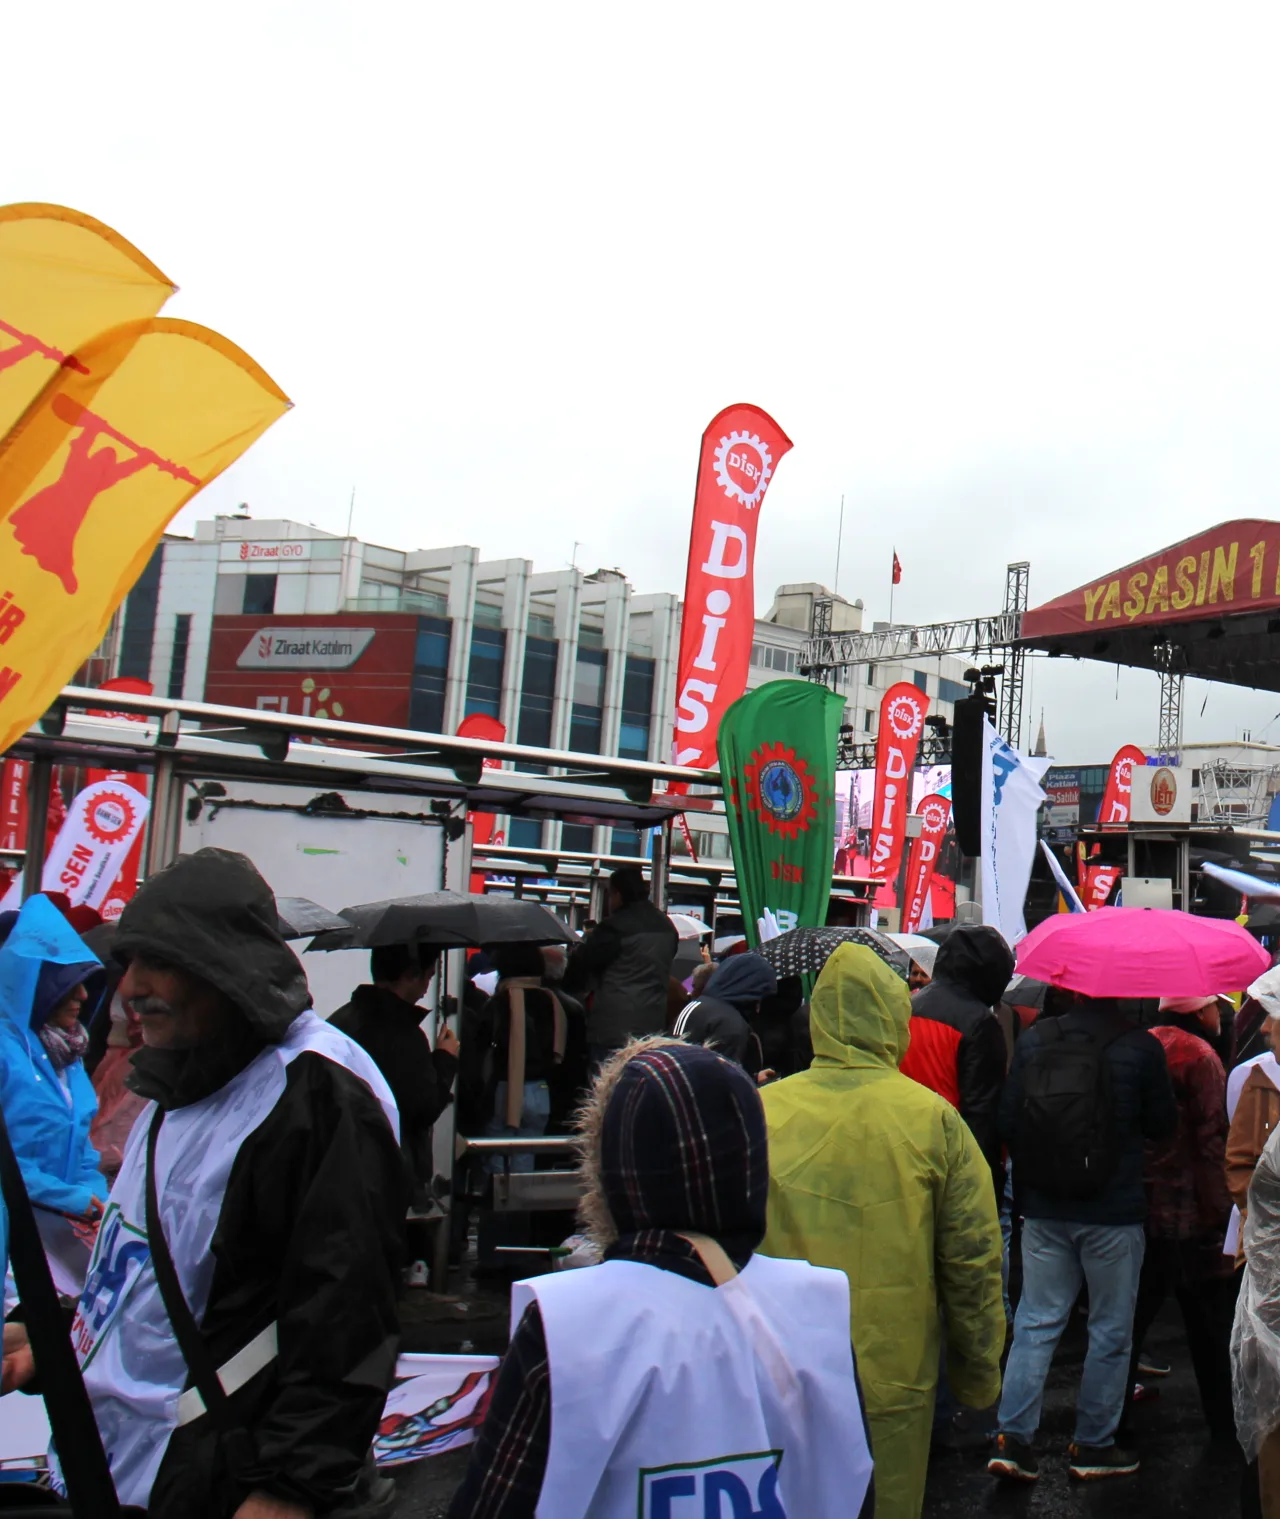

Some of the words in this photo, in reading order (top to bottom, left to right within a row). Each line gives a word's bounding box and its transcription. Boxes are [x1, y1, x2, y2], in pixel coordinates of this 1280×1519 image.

[251, 545, 279, 557] Ziraat
[282, 545, 303, 557] GYO
[1083, 541, 1240, 621] YAŞASIN
[1250, 541, 1266, 598] 1
[274, 640, 311, 655] Ziraat
[311, 640, 352, 655] Katılım
[1056, 791, 1079, 804] Satılık
